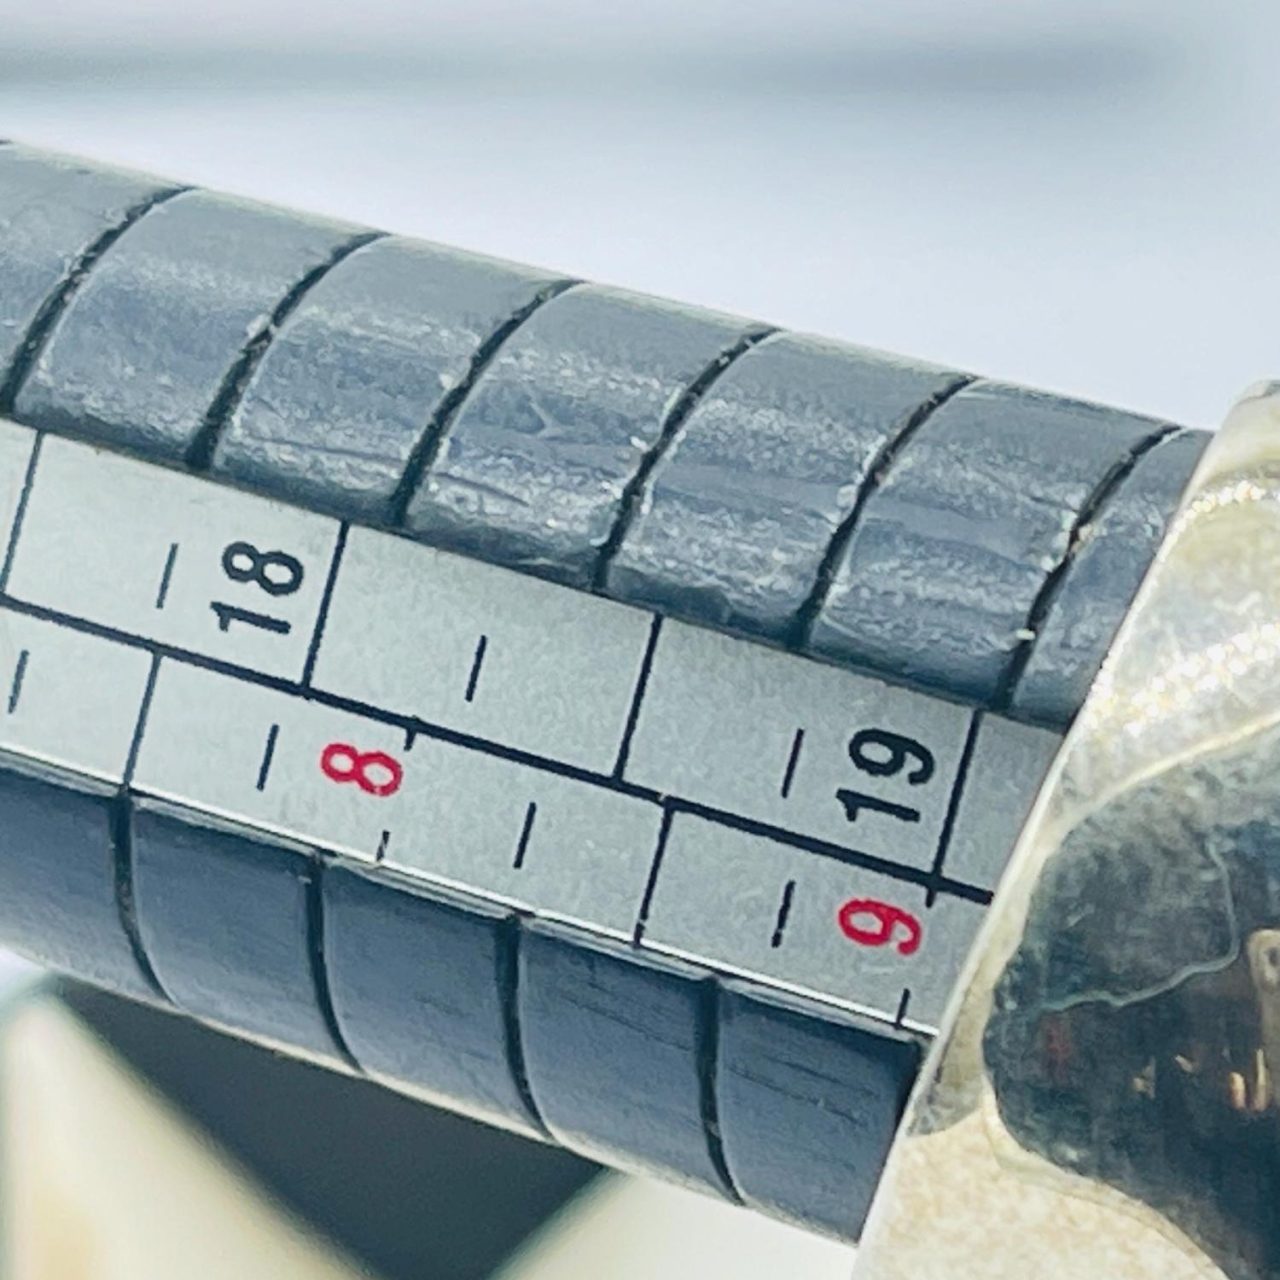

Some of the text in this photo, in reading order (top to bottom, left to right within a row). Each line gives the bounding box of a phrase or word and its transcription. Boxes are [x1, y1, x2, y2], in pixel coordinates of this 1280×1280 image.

[210, 541, 304, 635] 18
[319, 741, 404, 798] 8
[836, 728, 935, 822] 19
[836, 897, 923, 955] 9
